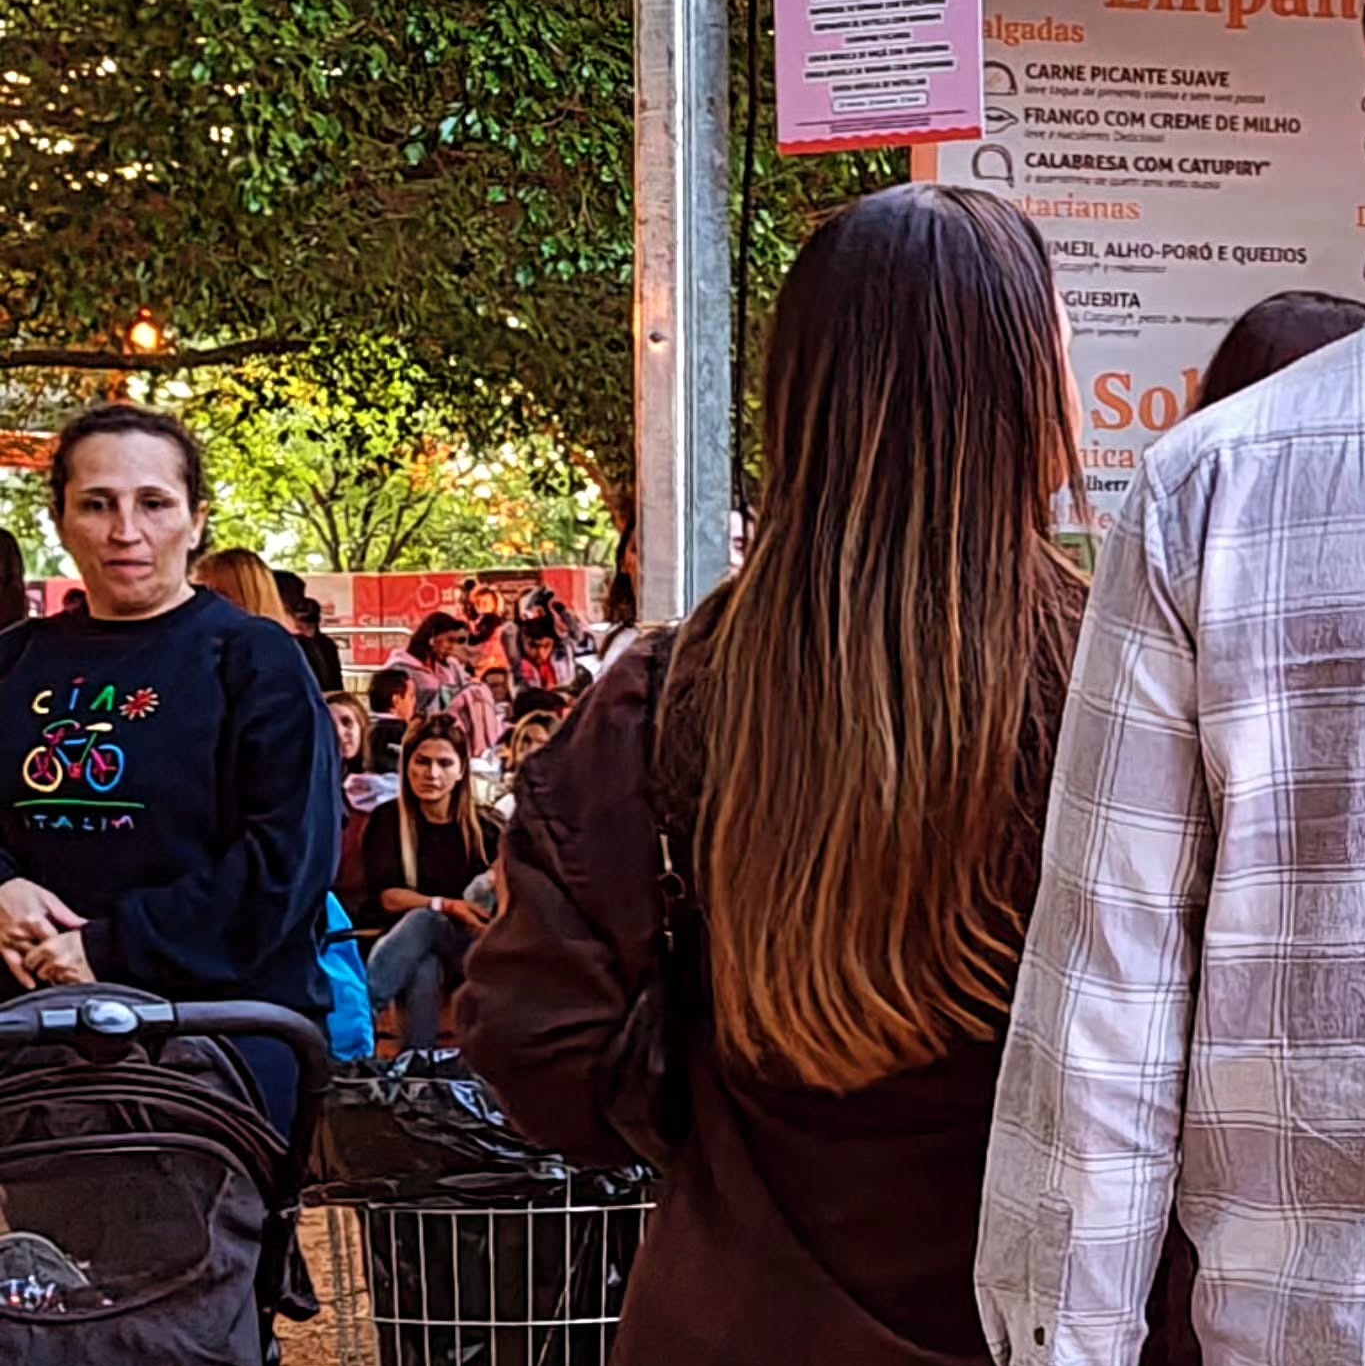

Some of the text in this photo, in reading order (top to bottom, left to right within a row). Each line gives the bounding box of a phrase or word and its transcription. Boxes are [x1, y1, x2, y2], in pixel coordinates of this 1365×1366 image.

[1024, 62, 1231, 88] CARNE PICANTE SUAVE
[1023, 107, 1302, 135] FRANGO COM CREME DE MILHO
[1024, 152, 1129, 173] CALABRESA
[1132, 156, 1174, 174] COM
[1217, 245, 1228, 262] E
[1058, 289, 1142, 310] GUERITA
